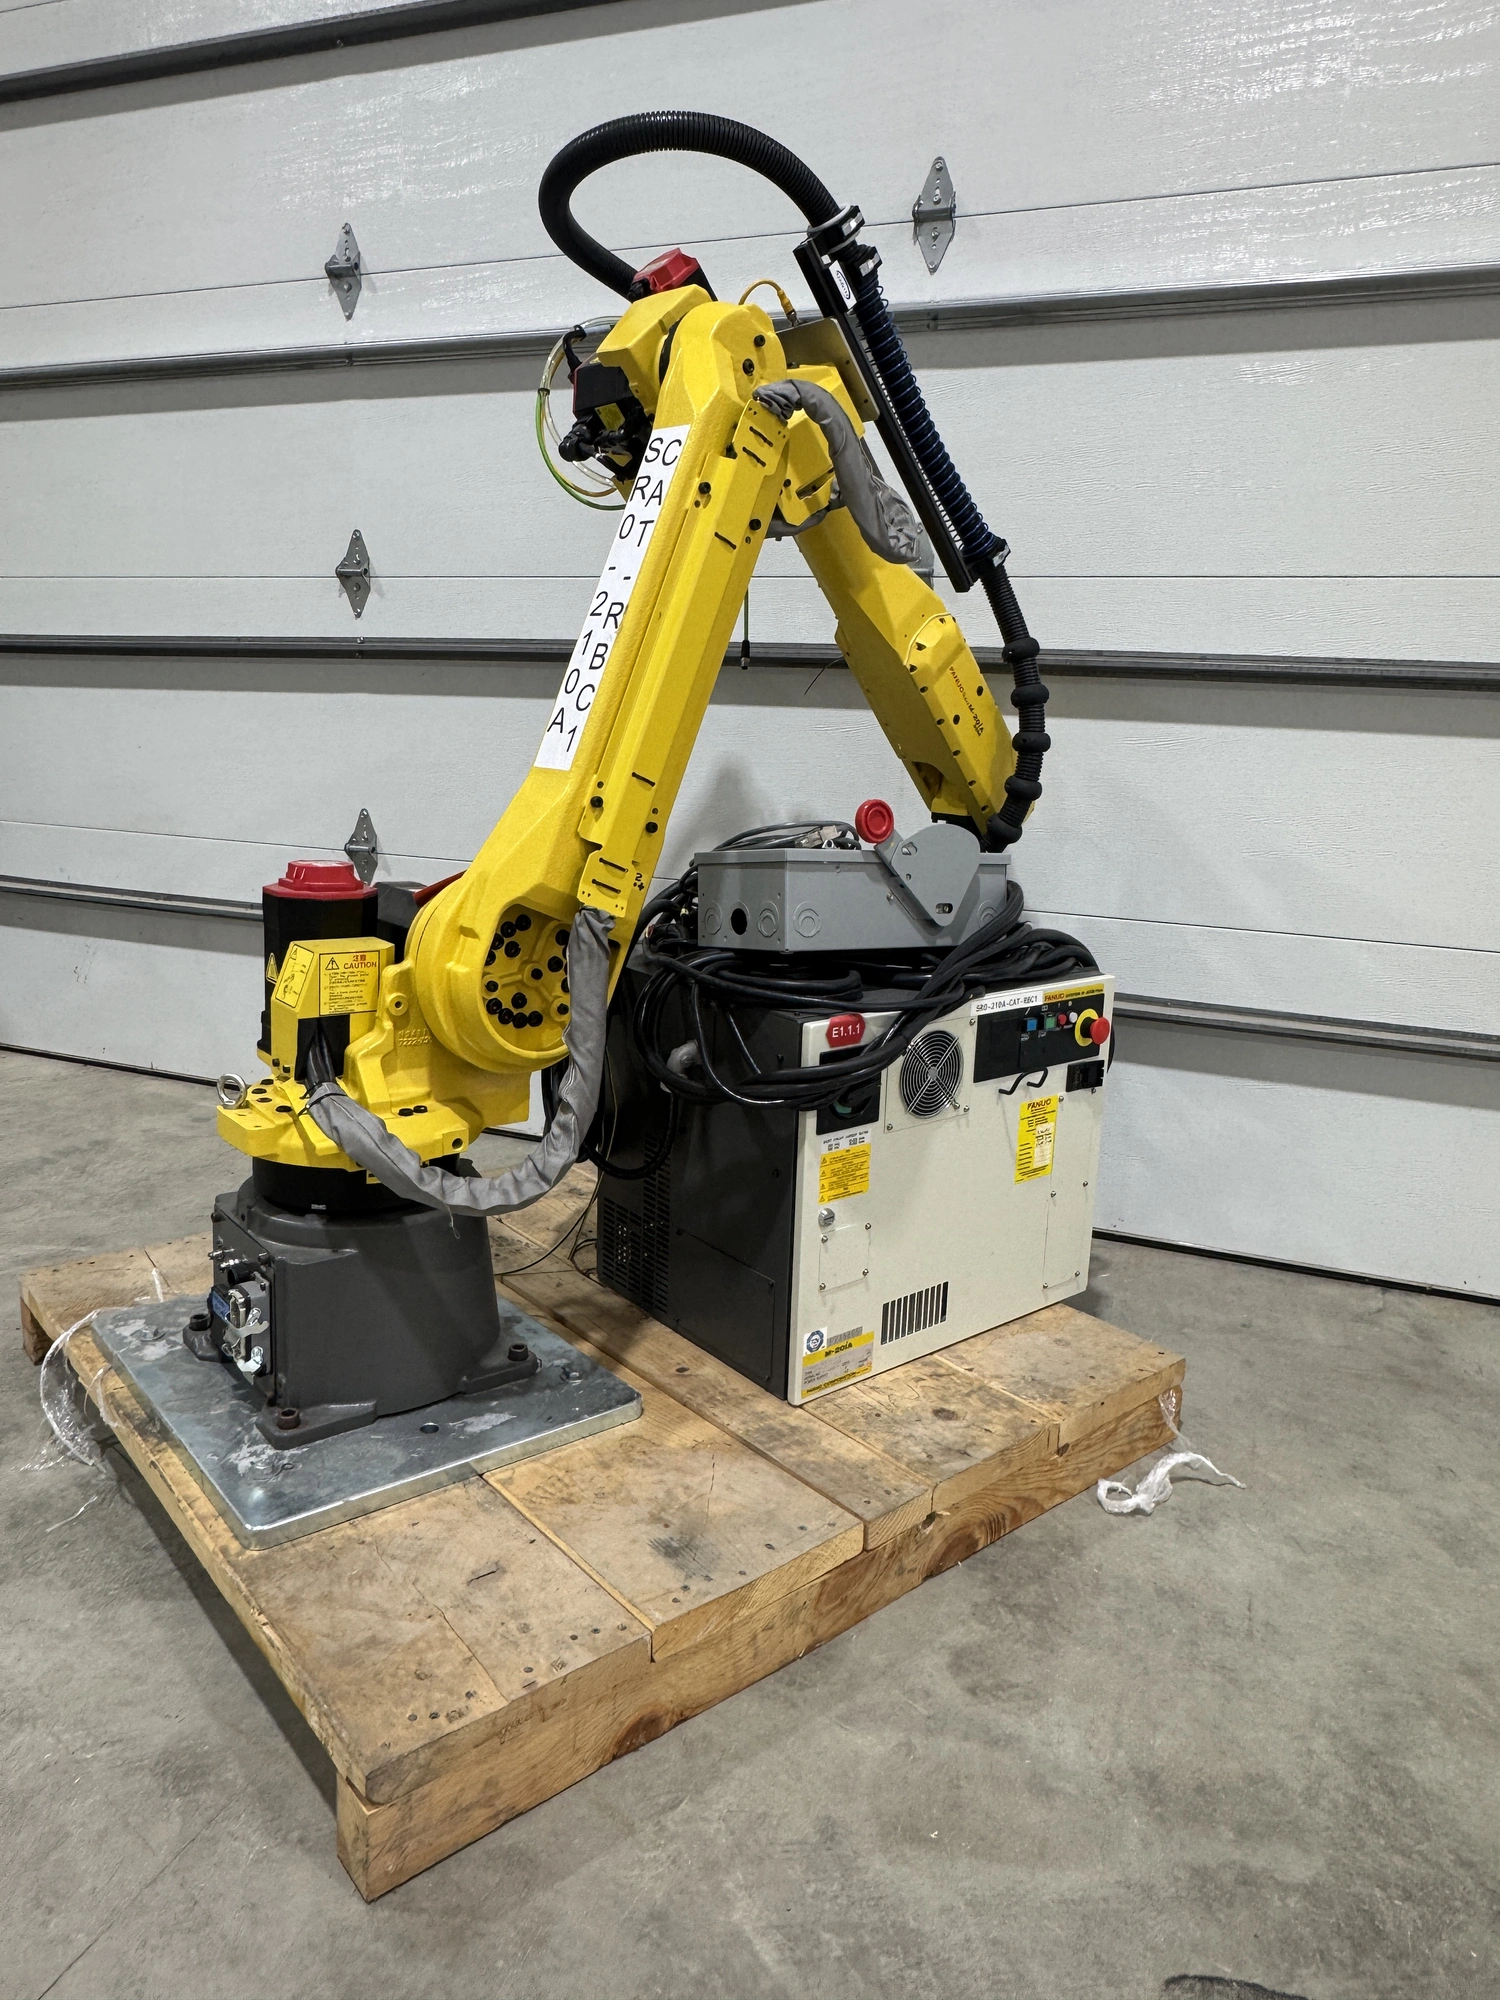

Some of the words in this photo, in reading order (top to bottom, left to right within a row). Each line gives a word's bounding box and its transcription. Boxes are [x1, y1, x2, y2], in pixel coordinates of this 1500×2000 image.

[343, 961, 378, 970] CAUTION
[831, 1023, 861, 1038] E1.1.1
[1027, 1098, 1052, 1110] FANUC
